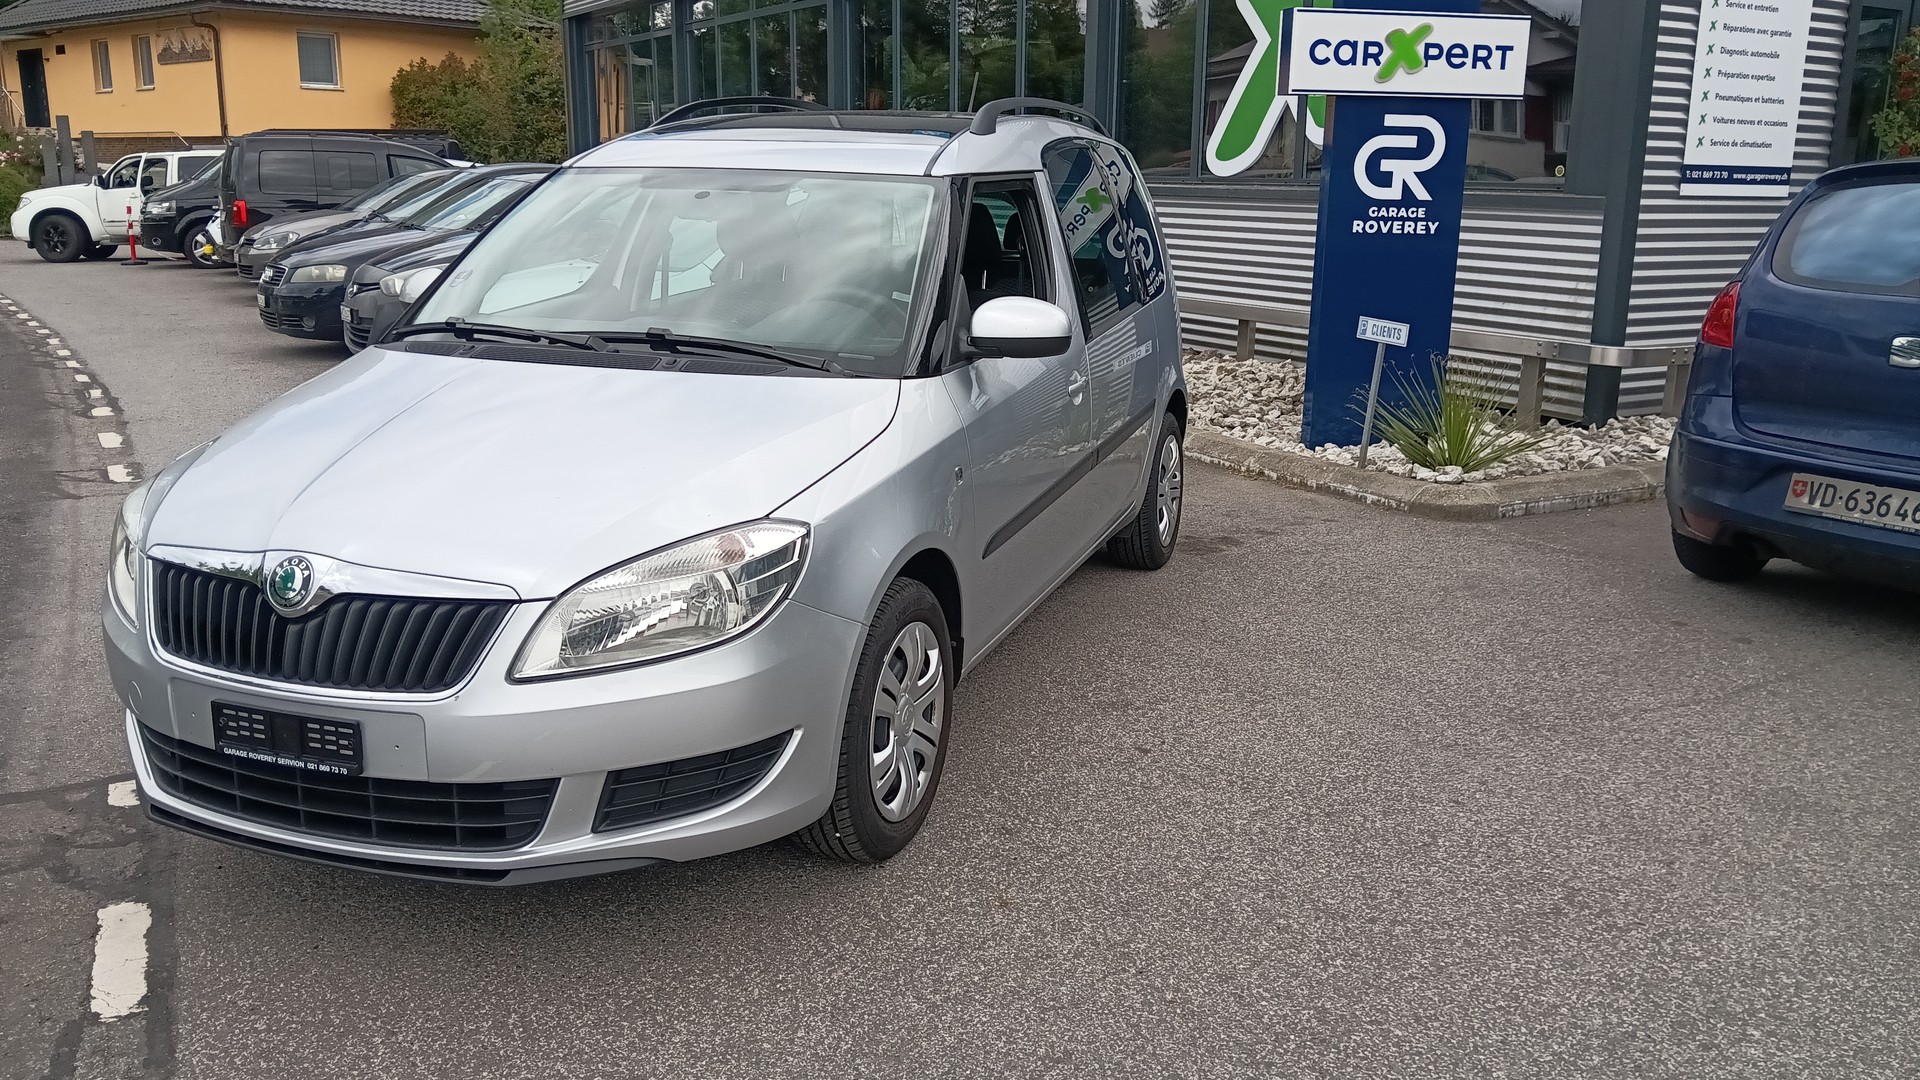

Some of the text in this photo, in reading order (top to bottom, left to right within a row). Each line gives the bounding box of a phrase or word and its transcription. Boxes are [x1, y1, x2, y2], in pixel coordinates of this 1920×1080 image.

[1725, 0, 1746, 10] Service
[1754, 4, 1779, 13] entretien
[1722, 23, 1792, 38] Réparations avec garantie
[1720, 46, 1780, 59] Diagnostic automobile
[1717, 69, 1776, 82] Préparation expertise
[1714, 92, 1753, 104] Pneumatiques
[1761, 96, 1785, 105] batteries
[1713, 115, 1736, 125] Voitures
[1737, 118, 1756, 126] neuves
[1763, 120, 1788, 128] occasions
[1710, 138, 1773, 149] Service de climatisation
[1691, 170, 1702, 178] 021
[1702, 170, 1713, 179] 869
[1713, 171, 1721, 179] 73
[1721, 171, 1729, 179] 70
[1368, 206, 1426, 218] GARAGE
[1352, 220, 1440, 235] ROVEREY
[1371, 323, 1402, 341] CLIENTS
[223, 747, 248, 758] GARAGE
[248, 752, 277, 763] ROVEREY
[277, 757, 305, 769] SERVION
[306, 762, 318, 770] 021
[331, 765, 339, 773] 73
[340, 767, 348, 775] 70
